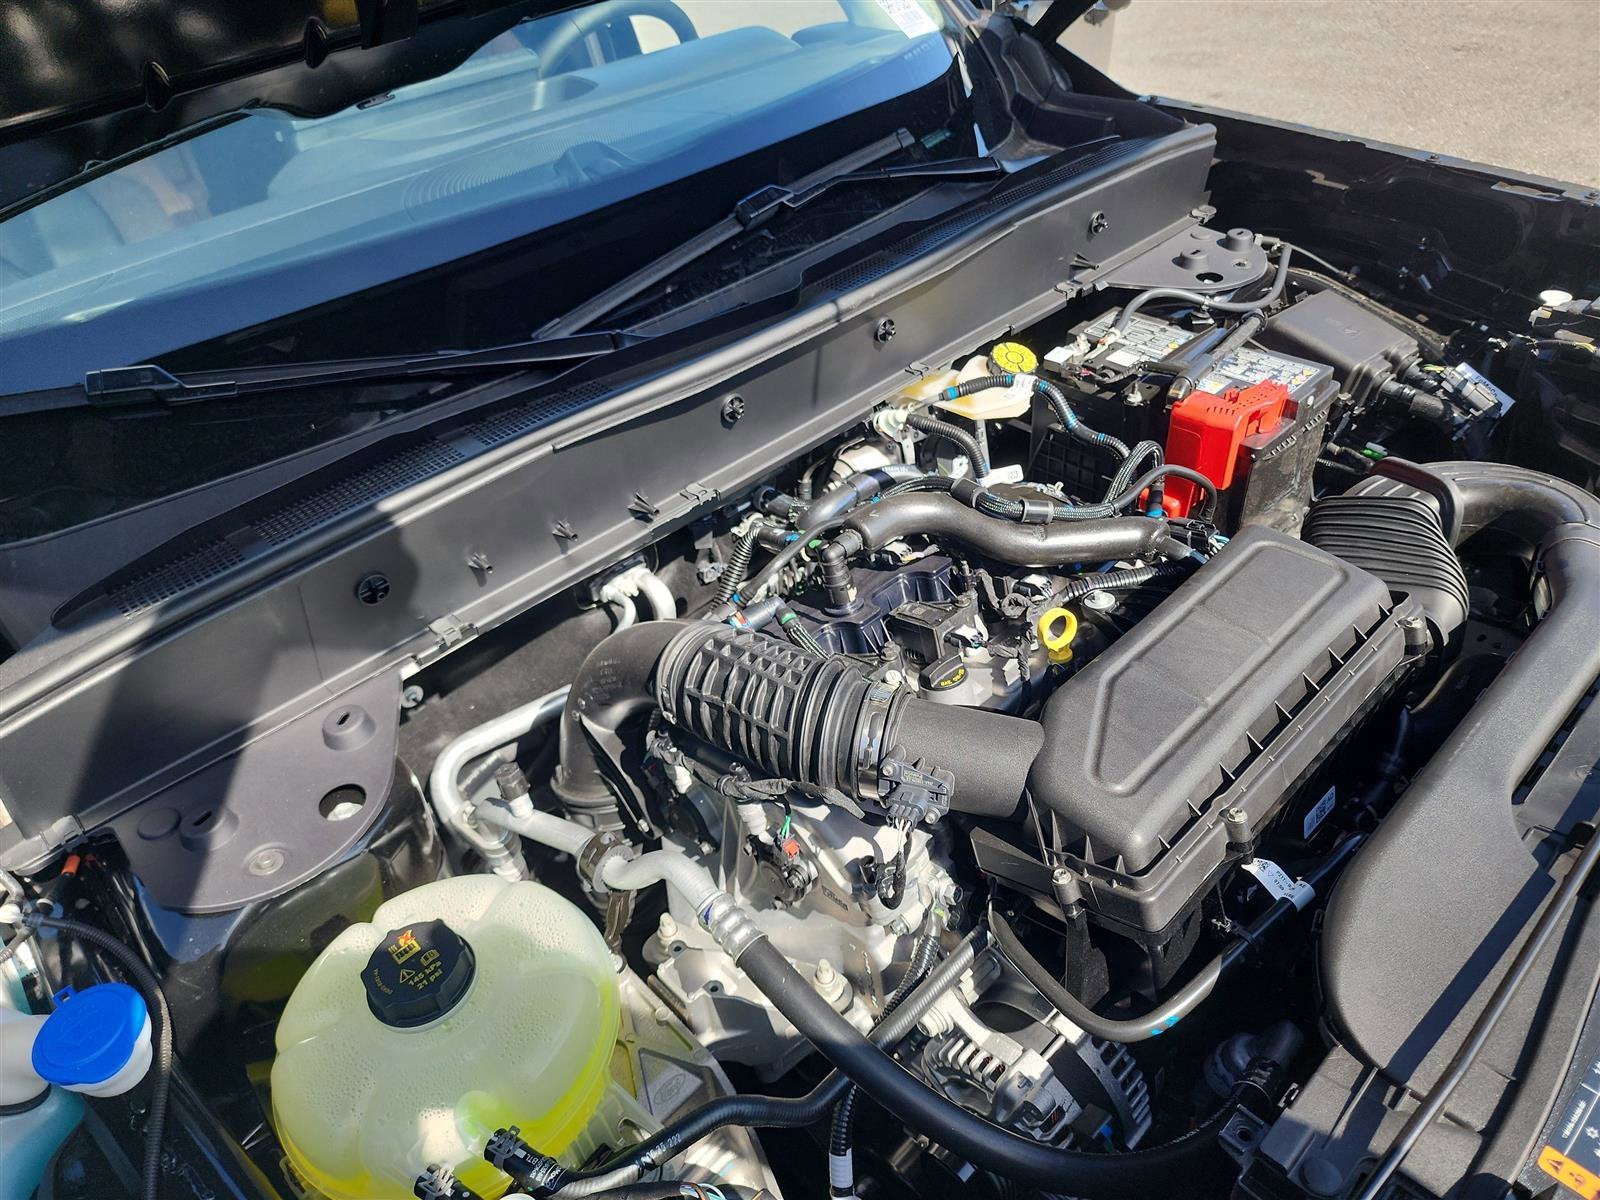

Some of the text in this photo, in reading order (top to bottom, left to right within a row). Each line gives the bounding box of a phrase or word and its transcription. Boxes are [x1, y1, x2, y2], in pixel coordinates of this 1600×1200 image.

[408, 972, 425, 986] 145
[425, 960, 442, 974] kPa
[416, 969, 443, 990] 21 psi
